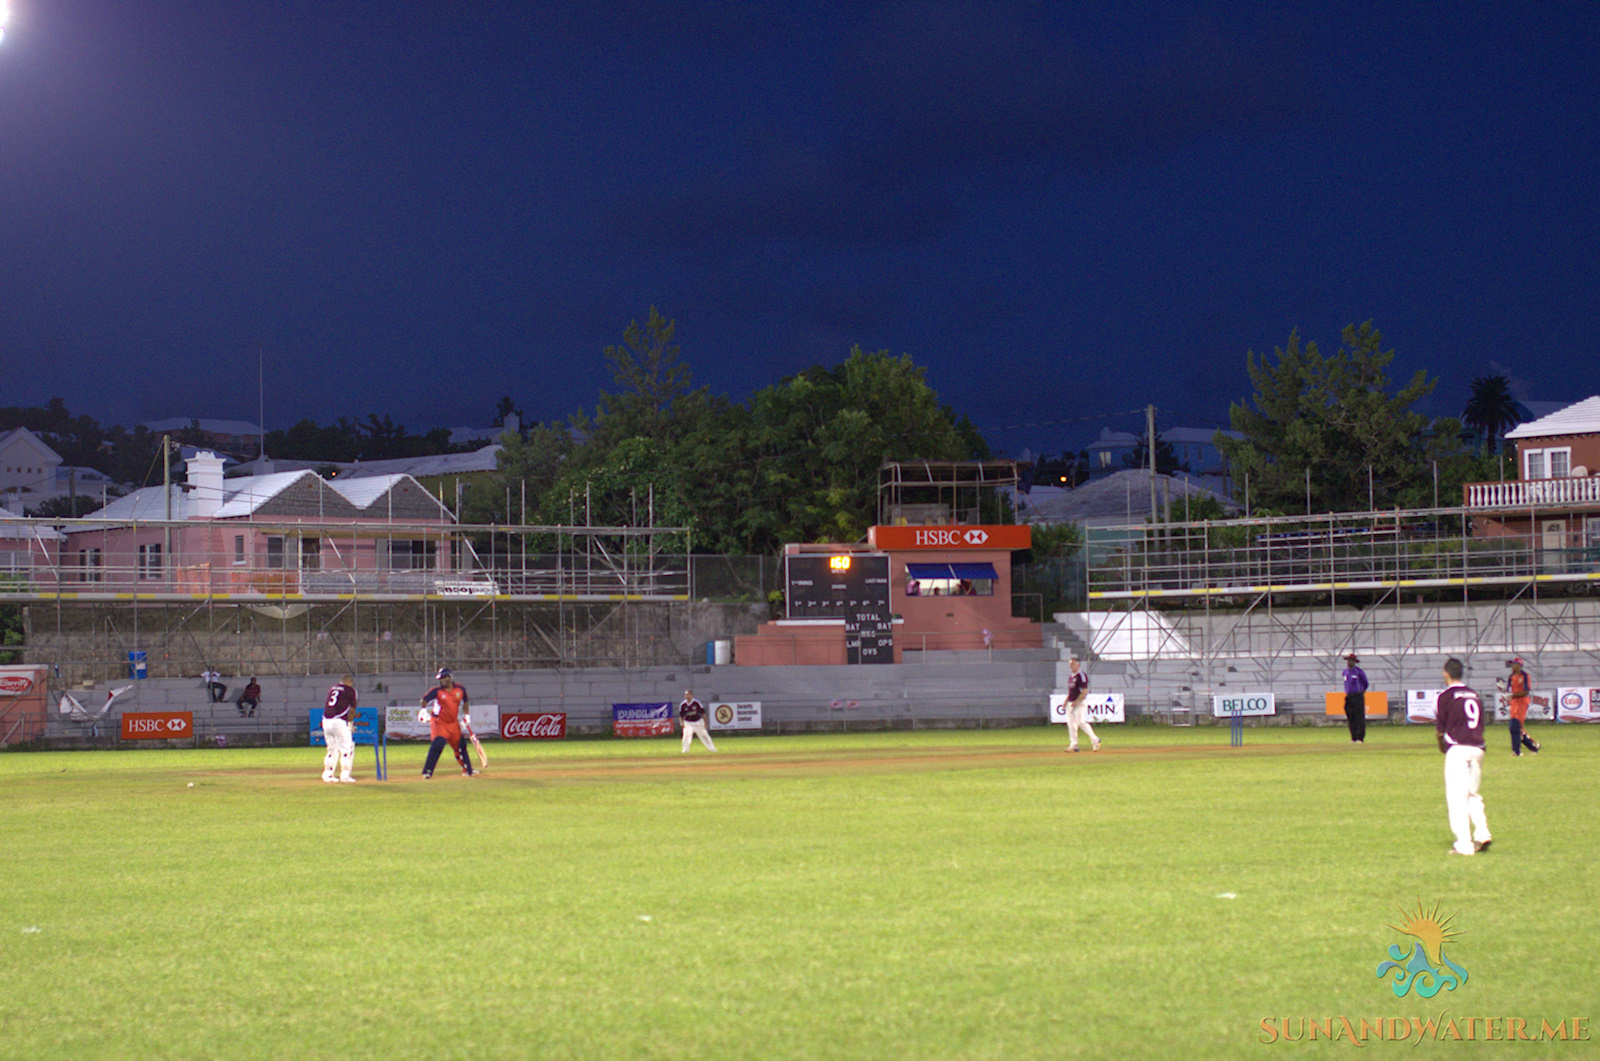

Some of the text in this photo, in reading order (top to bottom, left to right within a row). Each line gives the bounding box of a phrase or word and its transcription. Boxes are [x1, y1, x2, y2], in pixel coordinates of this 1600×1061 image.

[915, 530, 961, 545] HSBC
[830, 556, 851, 569] 160
[856, 613, 881, 621] TOTAL
[845, 622, 892, 631] BAT BAT
[328, 690, 340, 707] 3
[1222, 697, 1267, 712] BELCO
[1056, 704, 1115, 715] GMIN
[1464, 699, 1480, 729] 9
[128, 719, 165, 732] HSBC
[503, 714, 564, 738] Coca-Cola
